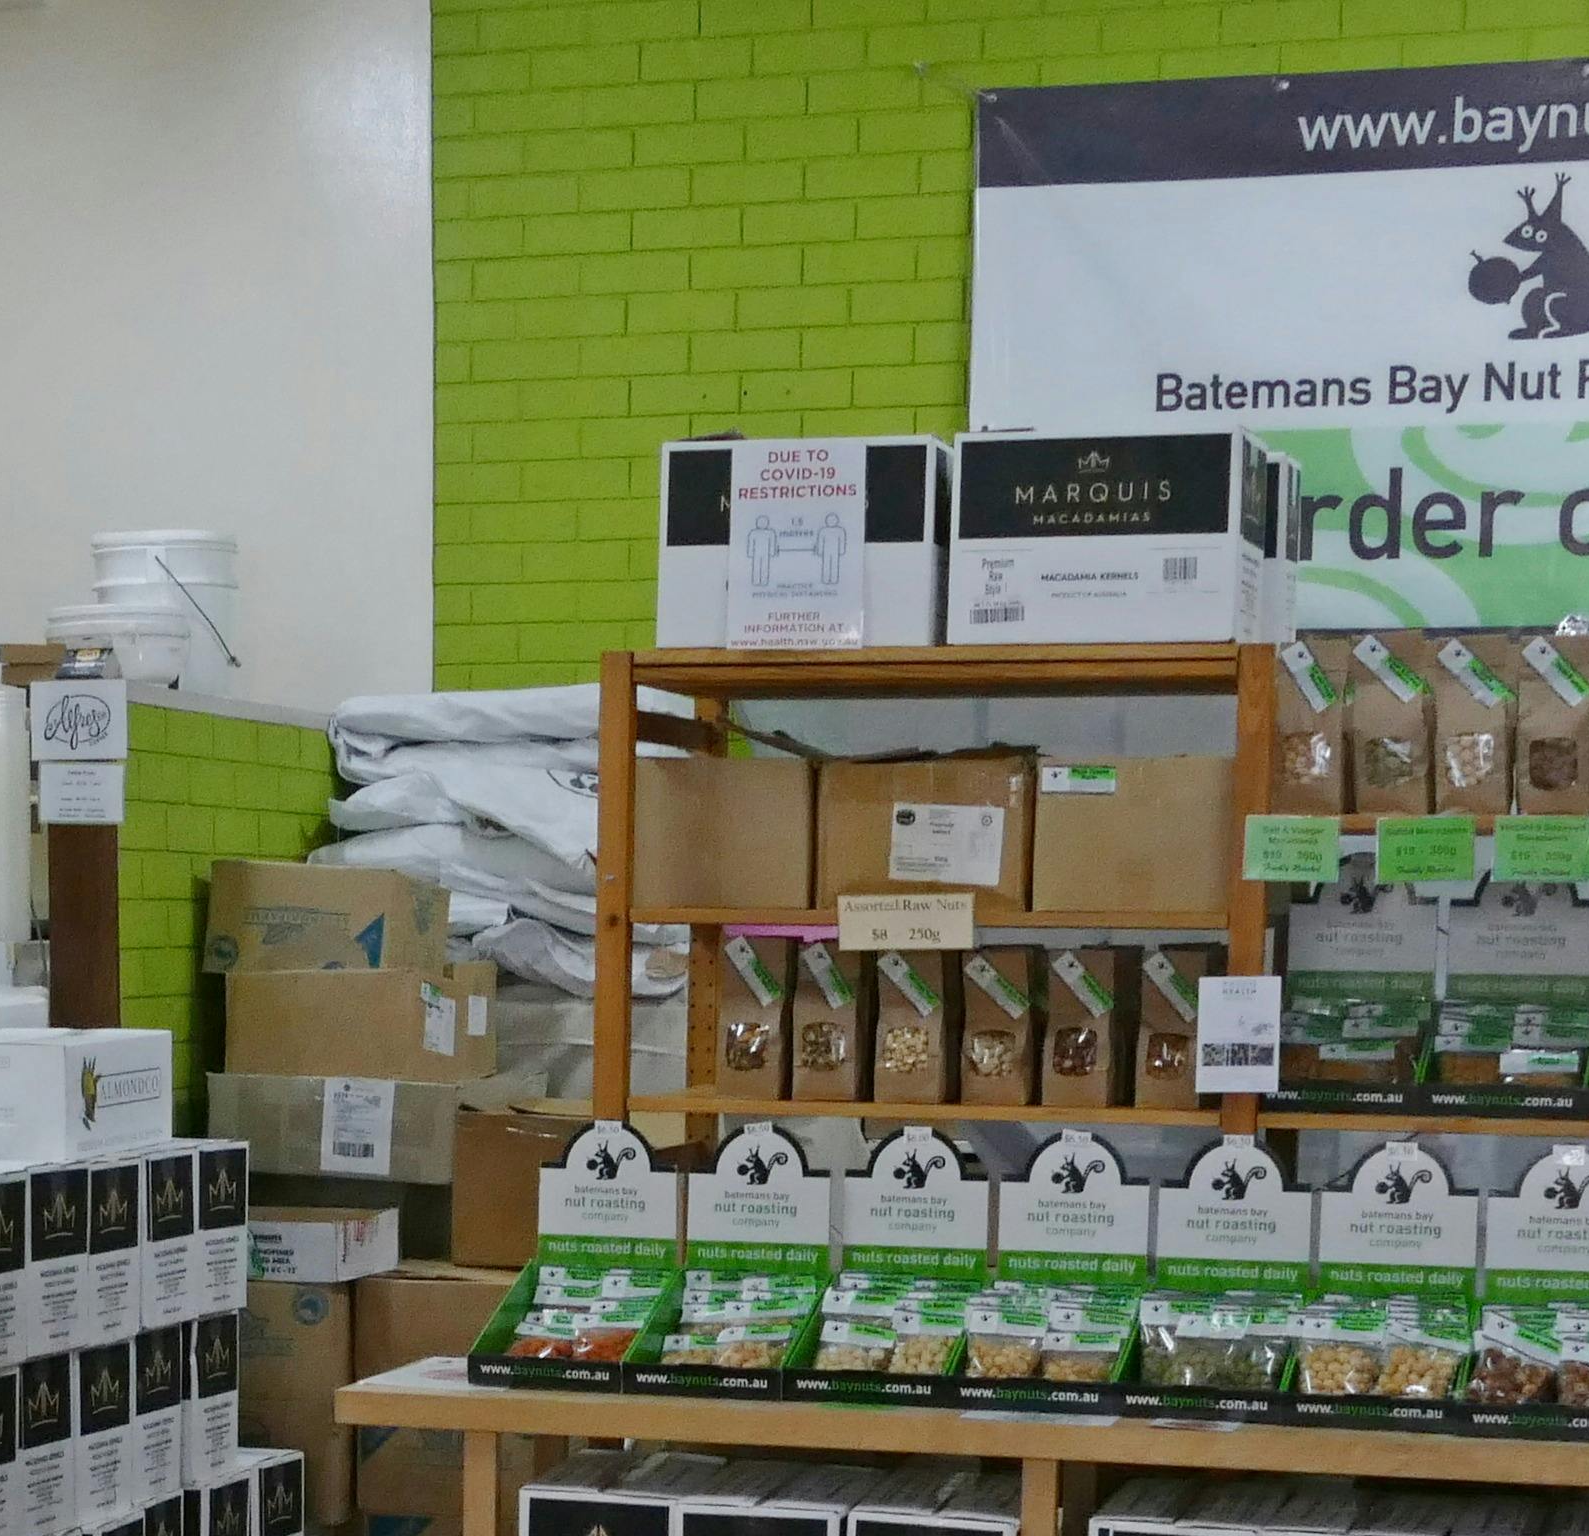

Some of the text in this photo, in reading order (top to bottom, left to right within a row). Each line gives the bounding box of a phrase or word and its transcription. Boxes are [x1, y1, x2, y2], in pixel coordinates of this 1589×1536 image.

[1155, 368, 1371, 413] Batemans
[1387, 363, 1468, 413] Bay
[1483, 361, 1560, 401] Nut
[769, 449, 829, 463] DUE TO
[760, 467, 836, 482] COVID-19
[738, 484, 857, 500] RESTRICTIONS
[1014, 479, 1172, 505] MARQUIS
[1032, 511, 1152, 525] MACADAMIAS
[1295, 467, 1525, 561] rder
[1040, 570, 1140, 582] MACADAMIA KERNELS
[768, 611, 821, 622] FURTHER
[744, 622, 845, 634] INFORMATION AT
[843, 898, 969, 913] Assorted Raw Nuts
[871, 927, 941, 943] $8 250g
[100, 1074, 160, 1101] ALMONDCO
[564, 1196, 646, 1212] nut roasting
[714, 1202, 798, 1217] nut roasting
[870, 1206, 956, 1222] nut roasting
[1186, 1217, 1277, 1234] nut roasting
[1516, 1228, 1543, 1241] nut
[634, 1245, 667, 1260] daily
[786, 1248, 819, 1266] daily
[1263, 1267, 1299, 1282] daily
[480, 1363, 610, 1382] www.baynuts.com.au
[636, 1371, 768, 1389] www.baynuts.com.au
[796, 1377, 932, 1395] www.baynuts.com.au
[1125, 1392, 1269, 1411] www.baynuts.com.au
